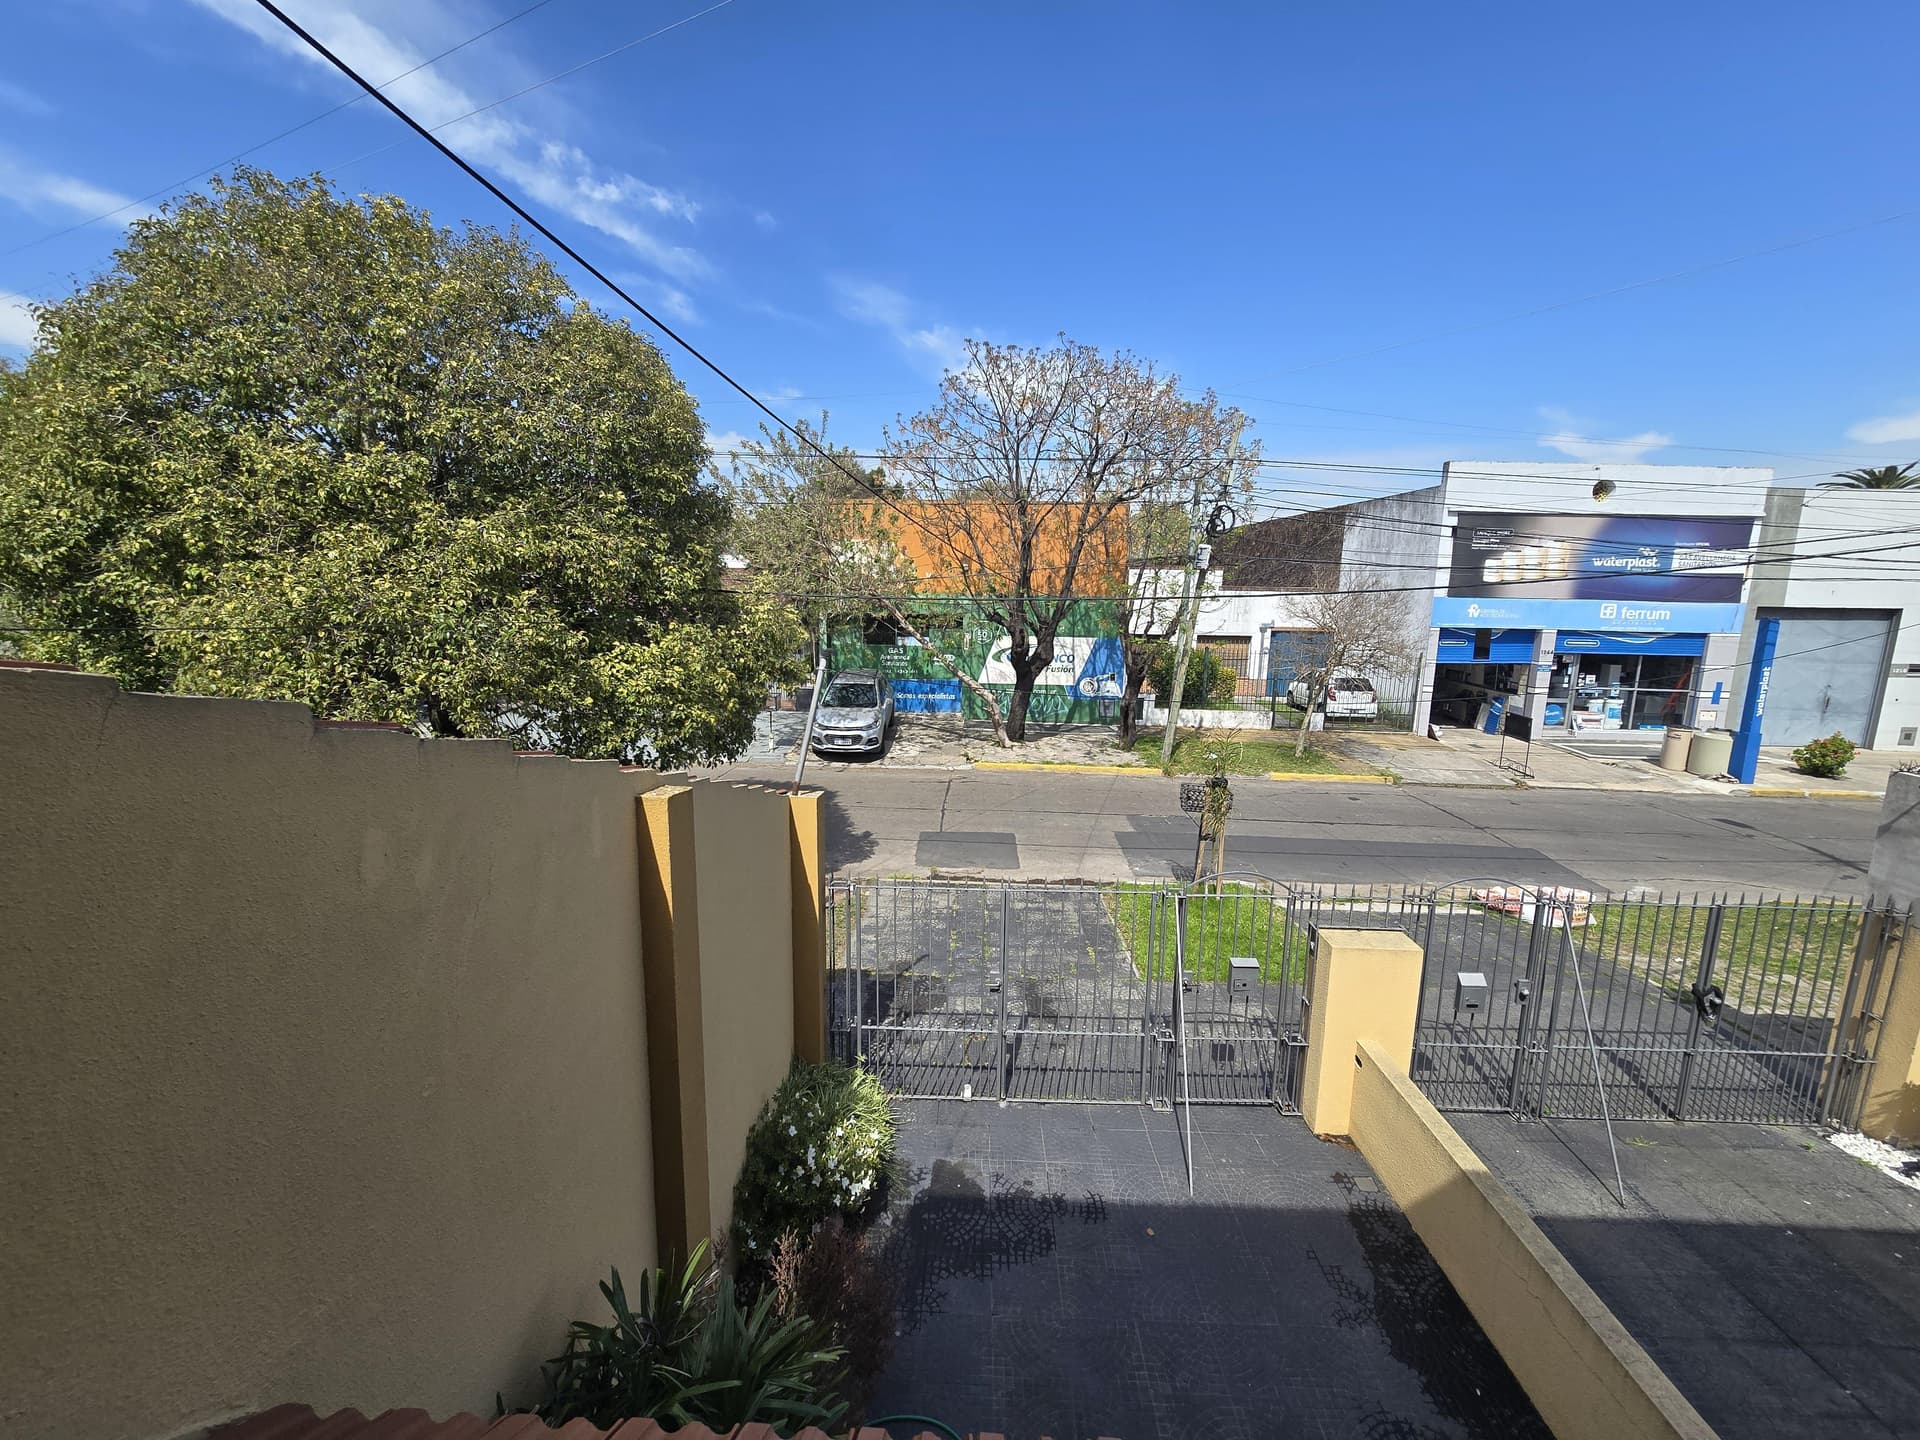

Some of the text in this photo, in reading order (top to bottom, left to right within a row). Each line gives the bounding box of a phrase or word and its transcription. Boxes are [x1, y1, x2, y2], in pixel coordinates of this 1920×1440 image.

[1592, 556, 1660, 570] waterplast
[1621, 606, 1671, 620] ferrum
[1756, 666, 1771, 717] waterplast
